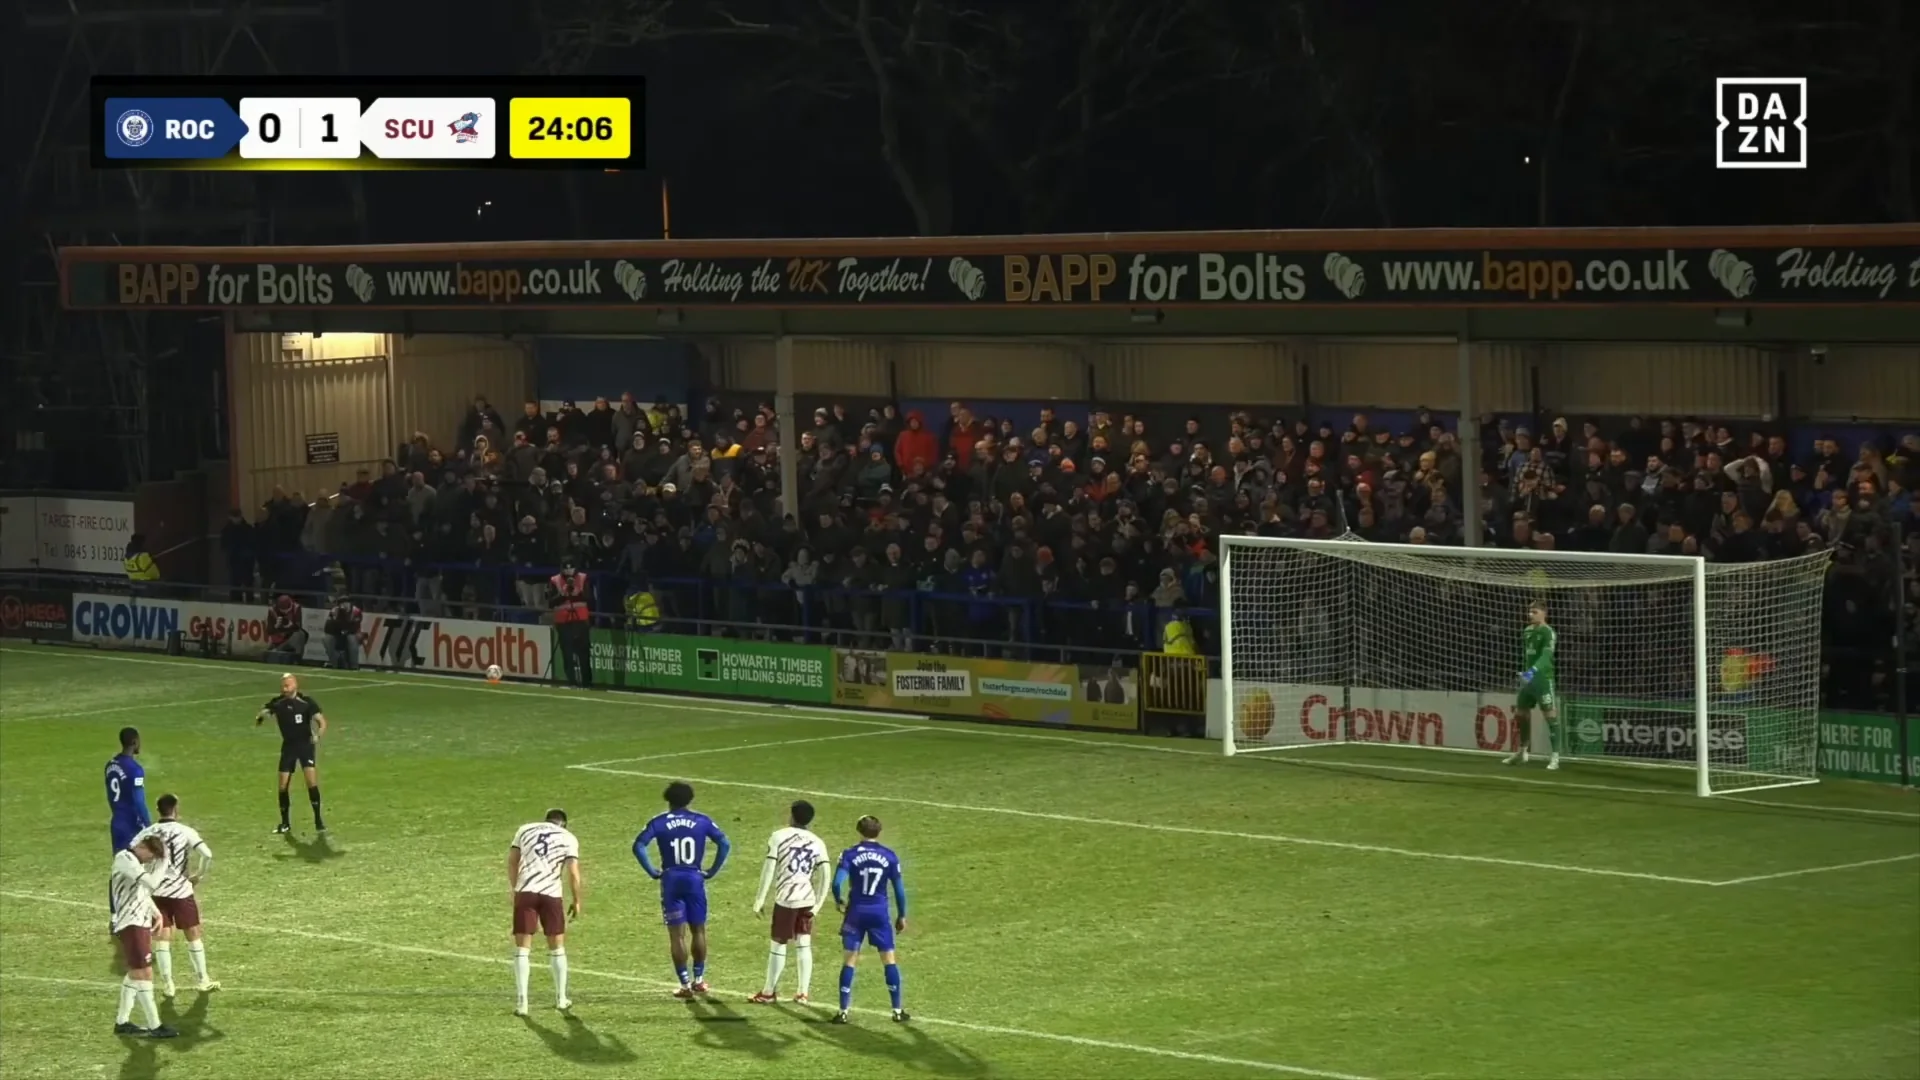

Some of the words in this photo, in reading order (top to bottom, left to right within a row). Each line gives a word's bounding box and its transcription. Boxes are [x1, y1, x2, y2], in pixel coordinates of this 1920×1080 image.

[118, 263, 199, 305] BAPP
[207, 264, 250, 304] for
[256, 263, 334, 304] Bolts
[386, 259, 602, 302] www.bapp.co.uk
[660, 258, 744, 302] Holding
[751, 258, 781, 292] the
[786, 256, 833, 294] UK
[837, 256, 933, 302] Together!
[1003, 254, 1117, 302] BAPP
[1128, 253, 1189, 301] for
[1198, 252, 1307, 301] Bolts
[1382, 249, 1691, 300] www.bapp.co.uk
[1776, 247, 1898, 299] Holding
[75, 600, 179, 642] CROWN
[190, 615, 226, 641] GAS
[433, 621, 540, 675] health
[642, 645, 683, 663] TIMBER
[638, 660, 683, 677] SUPPLIES
[721, 652, 778, 671] HOWARTH
[780, 656, 823, 674] TIMBER
[722, 667, 730, 681] &
[731, 667, 775, 685] BUILDING
[776, 671, 823, 688] SUPPLIES
[895, 674, 936, 691] FOSTERING
[937, 675, 965, 692] FAMILY
[1300, 694, 1443, 746] Crown
[1475, 704, 1520, 753] Oi
[1577, 718, 1745, 754] enterprse
[1820, 723, 1860, 747] HERE
[1864, 725, 1893, 749] FOR
[110, 777, 121, 802] 9
[666, 818, 697, 831] RODNEY
[534, 833, 549, 858] 5
[669, 836, 696, 865] 10
[852, 851, 890, 868] PRITCHARD
[859, 867, 884, 896] 17
